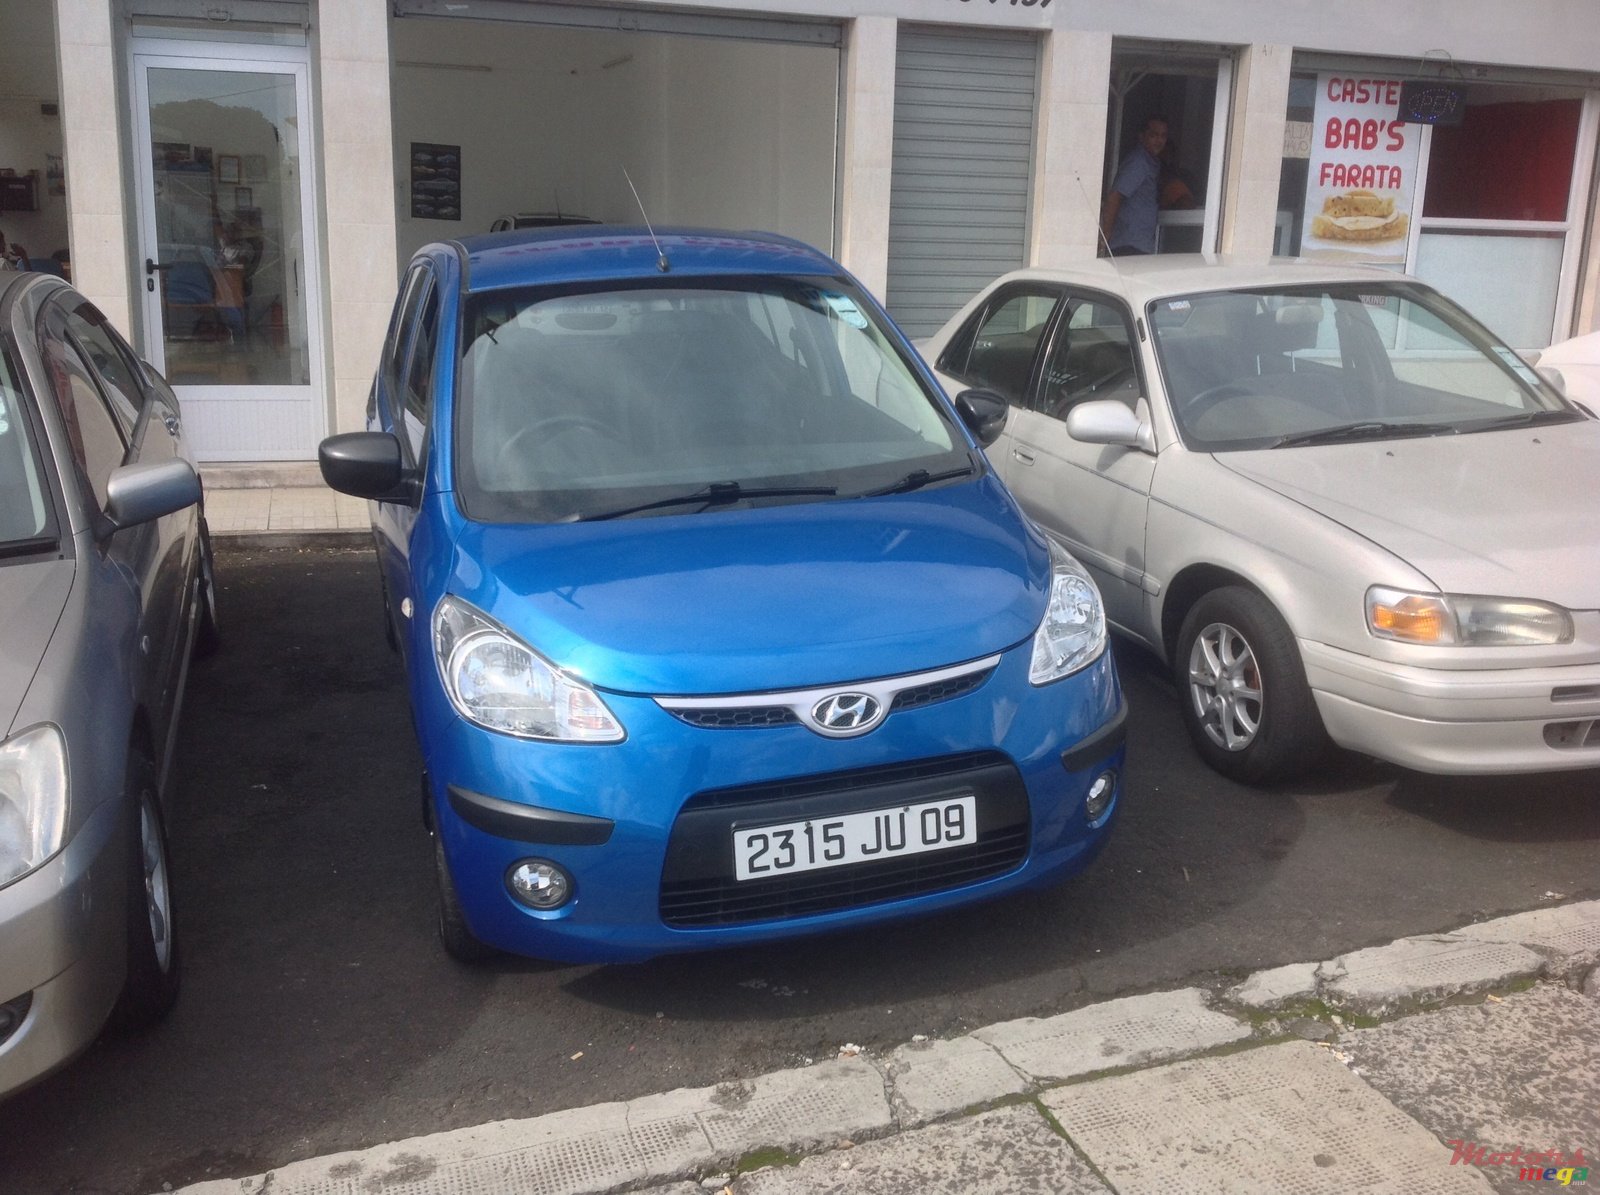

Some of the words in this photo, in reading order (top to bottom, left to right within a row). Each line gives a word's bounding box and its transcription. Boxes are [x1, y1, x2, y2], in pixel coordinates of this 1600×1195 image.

[1324, 117, 1406, 152] BAB'S
[1319, 162, 1402, 190] FARATA
[746, 821, 846, 874] 2315
[860, 811, 906, 856] JU
[920, 803, 965, 846] 09
